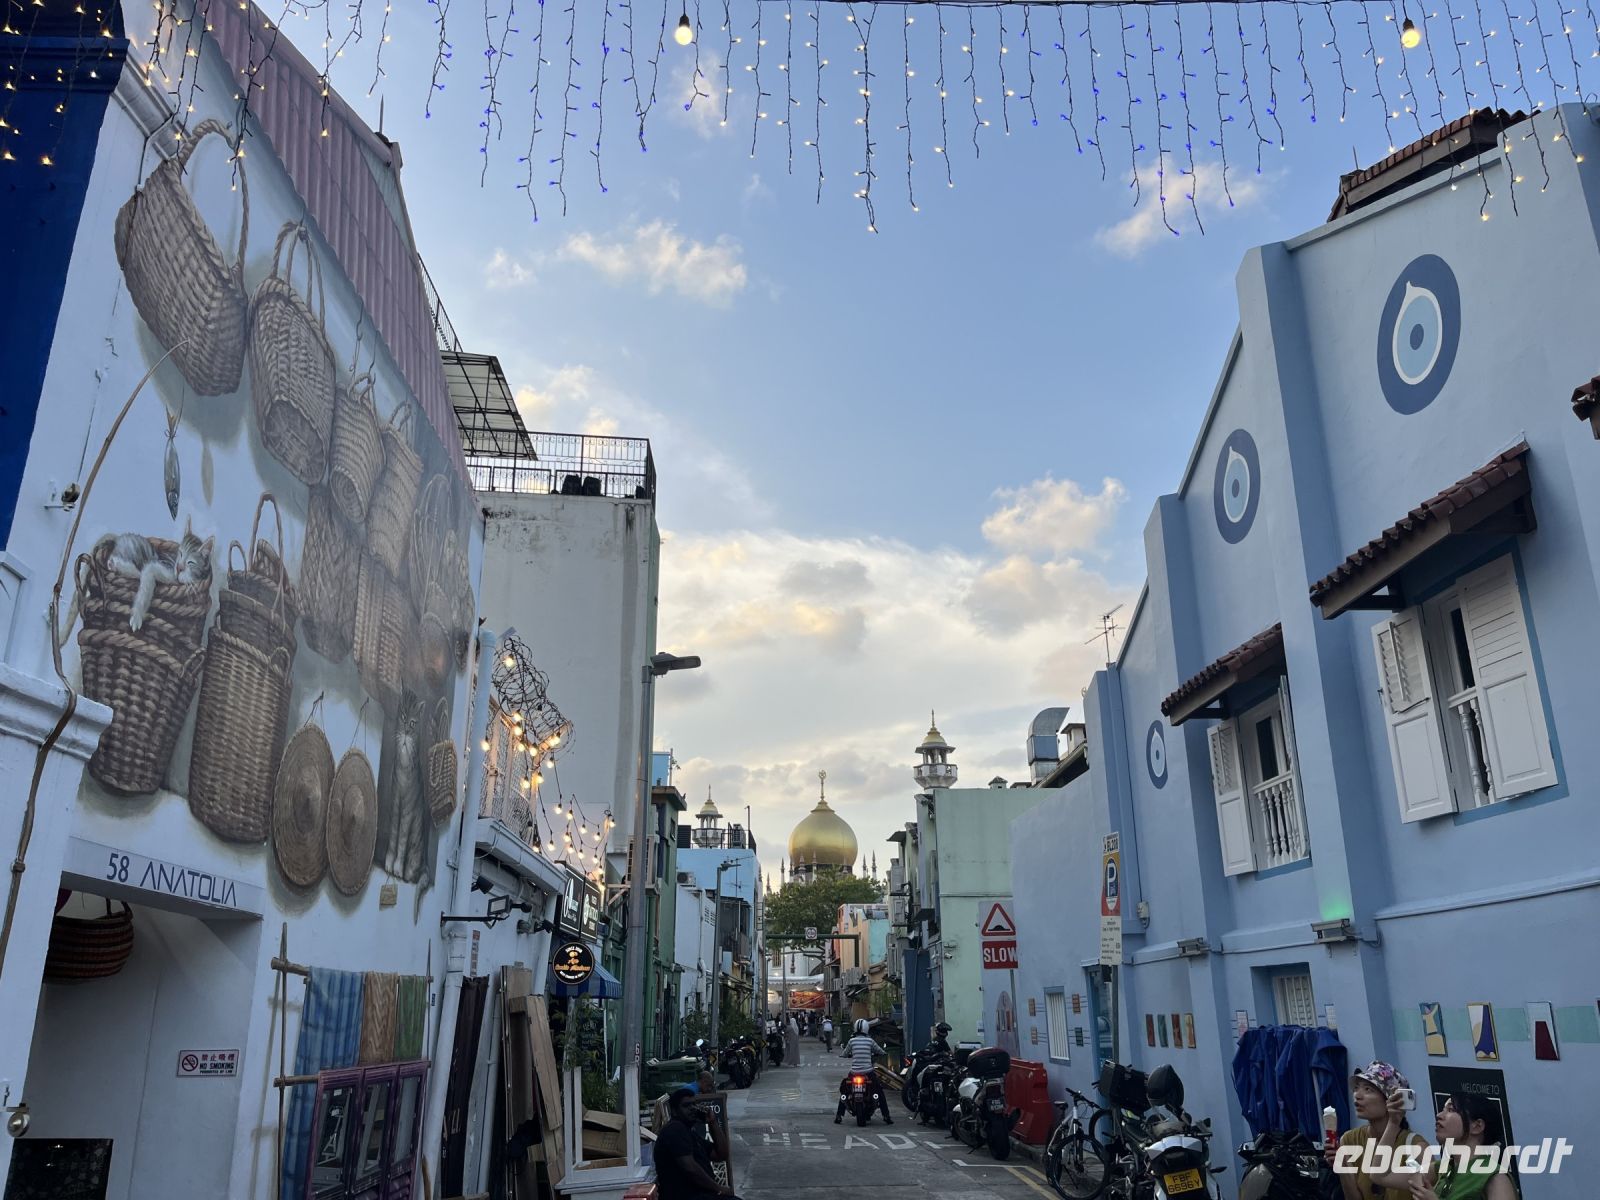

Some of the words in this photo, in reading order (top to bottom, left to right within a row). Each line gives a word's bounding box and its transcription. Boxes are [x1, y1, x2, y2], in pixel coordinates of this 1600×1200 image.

[107, 853, 130, 882] 58
[140, 861, 236, 907] ANATOLIA
[983, 947, 1018, 962] SLOW
[1460, 1082, 1491, 1094] WELCOME
